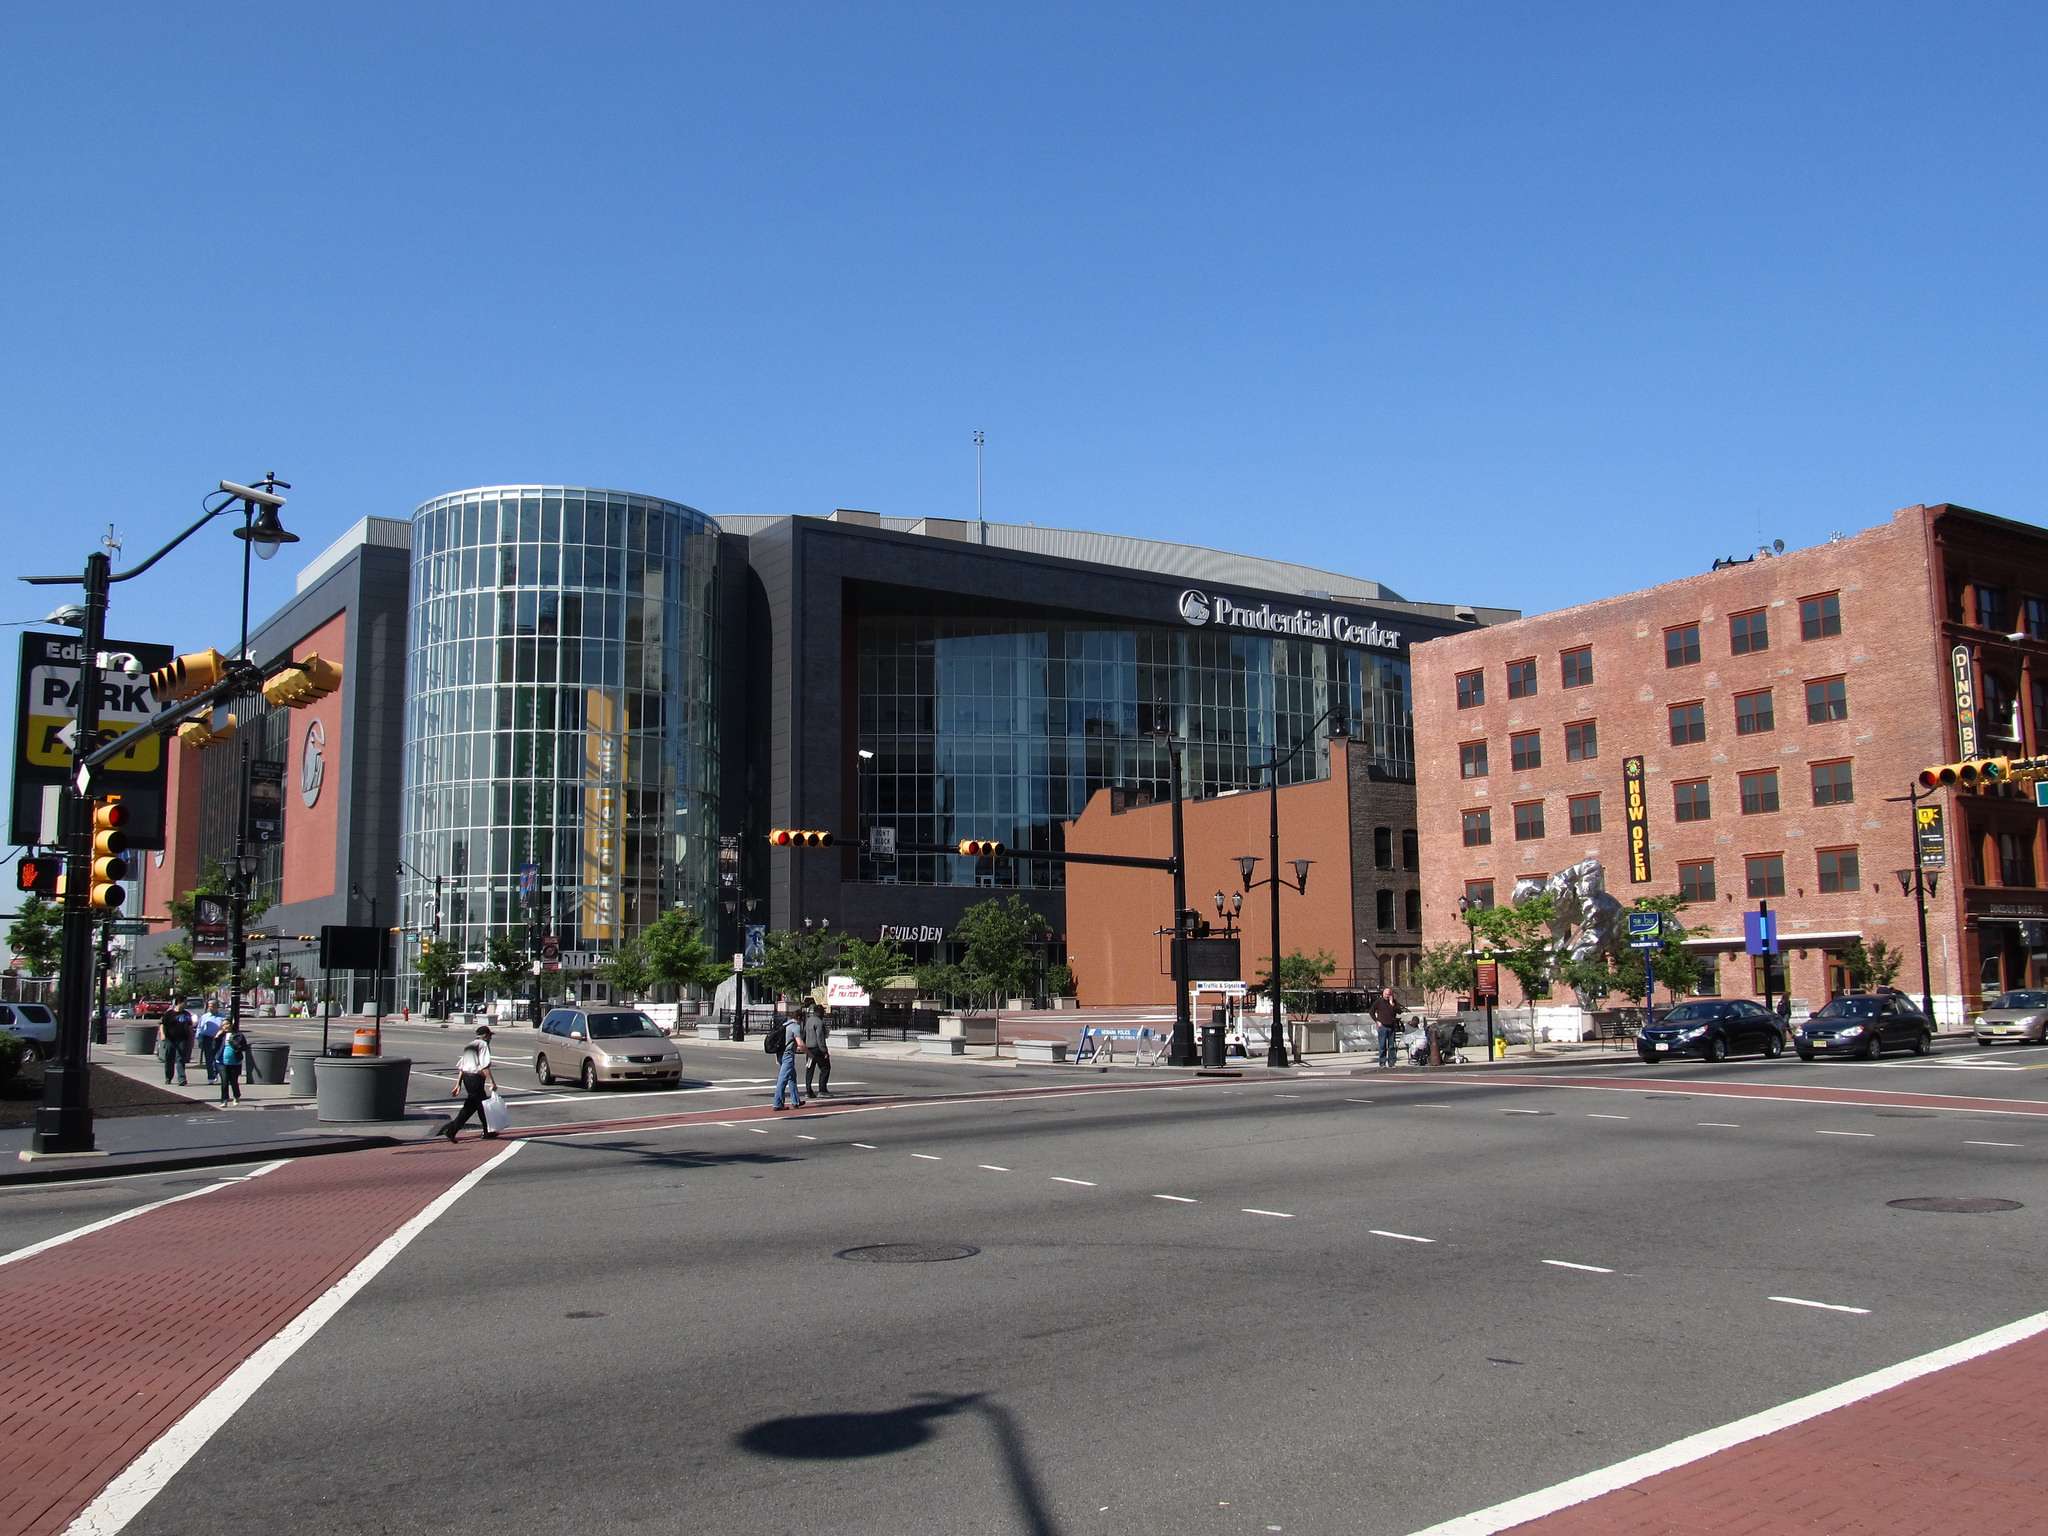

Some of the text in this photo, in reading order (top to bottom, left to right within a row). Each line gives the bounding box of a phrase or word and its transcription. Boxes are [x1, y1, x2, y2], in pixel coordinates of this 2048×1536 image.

[1213, 597, 1401, 650] Prudential Center
[1955, 653, 1971, 709] DINO
[1628, 779, 1646, 881] NOW OPEN
[880, 925, 943, 945] DEVILS DEN
